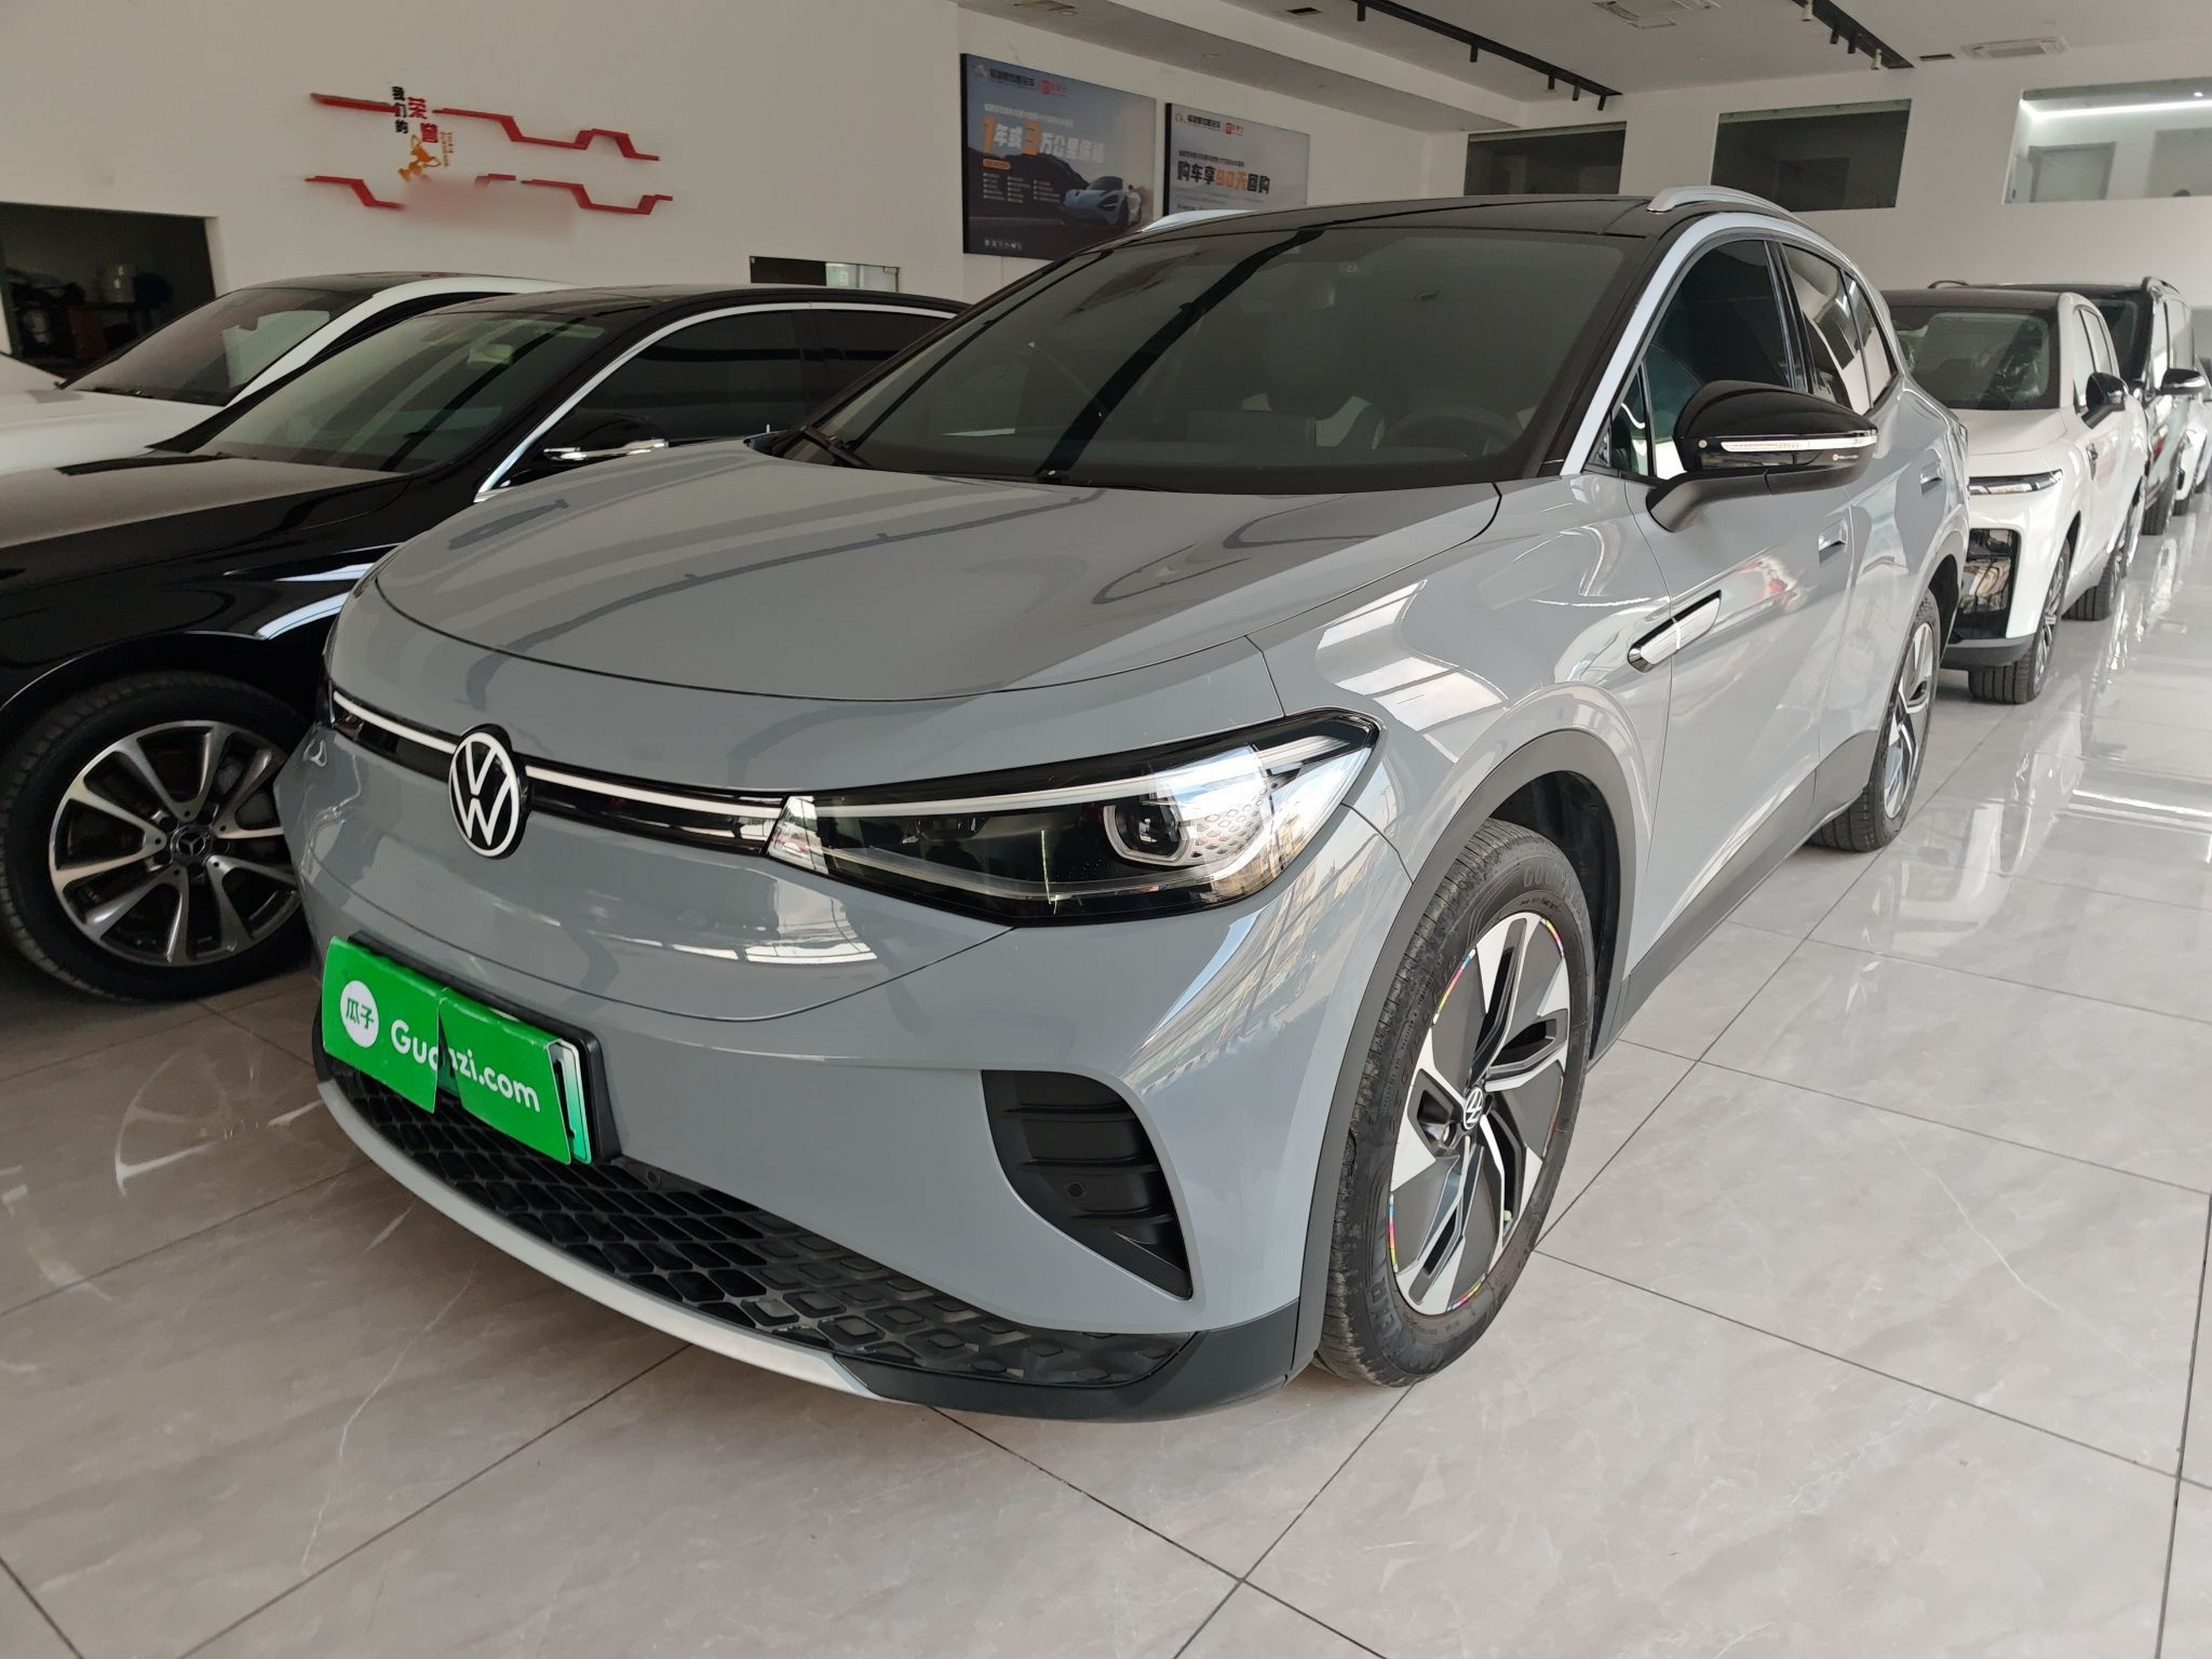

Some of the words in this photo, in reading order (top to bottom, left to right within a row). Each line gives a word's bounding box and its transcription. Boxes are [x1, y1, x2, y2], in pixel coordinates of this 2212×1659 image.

[1177, 160, 1270, 195] 购车享90天回购
[344, 996, 376, 1030] 瓜子
